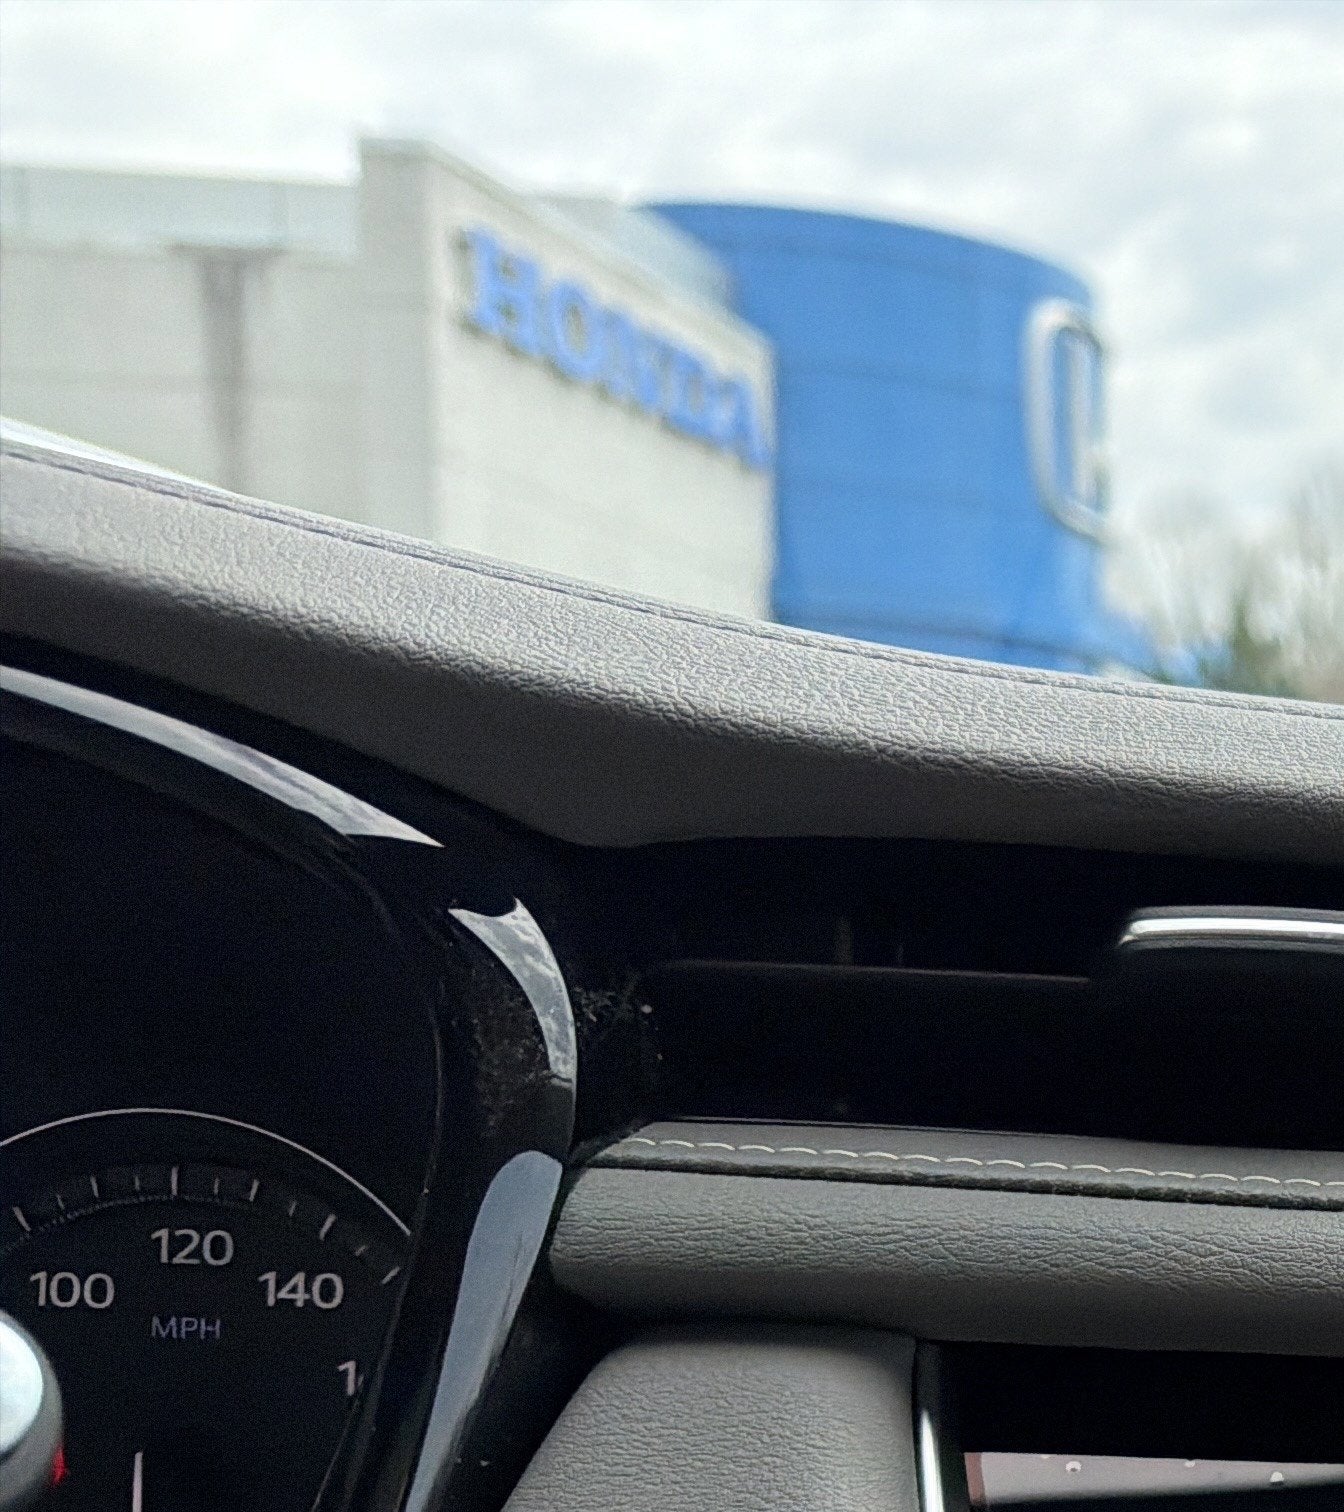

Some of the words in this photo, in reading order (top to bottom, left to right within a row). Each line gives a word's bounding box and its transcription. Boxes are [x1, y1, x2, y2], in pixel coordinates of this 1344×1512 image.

[151, 1228, 235, 1266] 120
[28, 1271, 116, 1309] 100
[258, 1271, 344, 1309] 140
[150, 1315, 222, 1341] MPH
